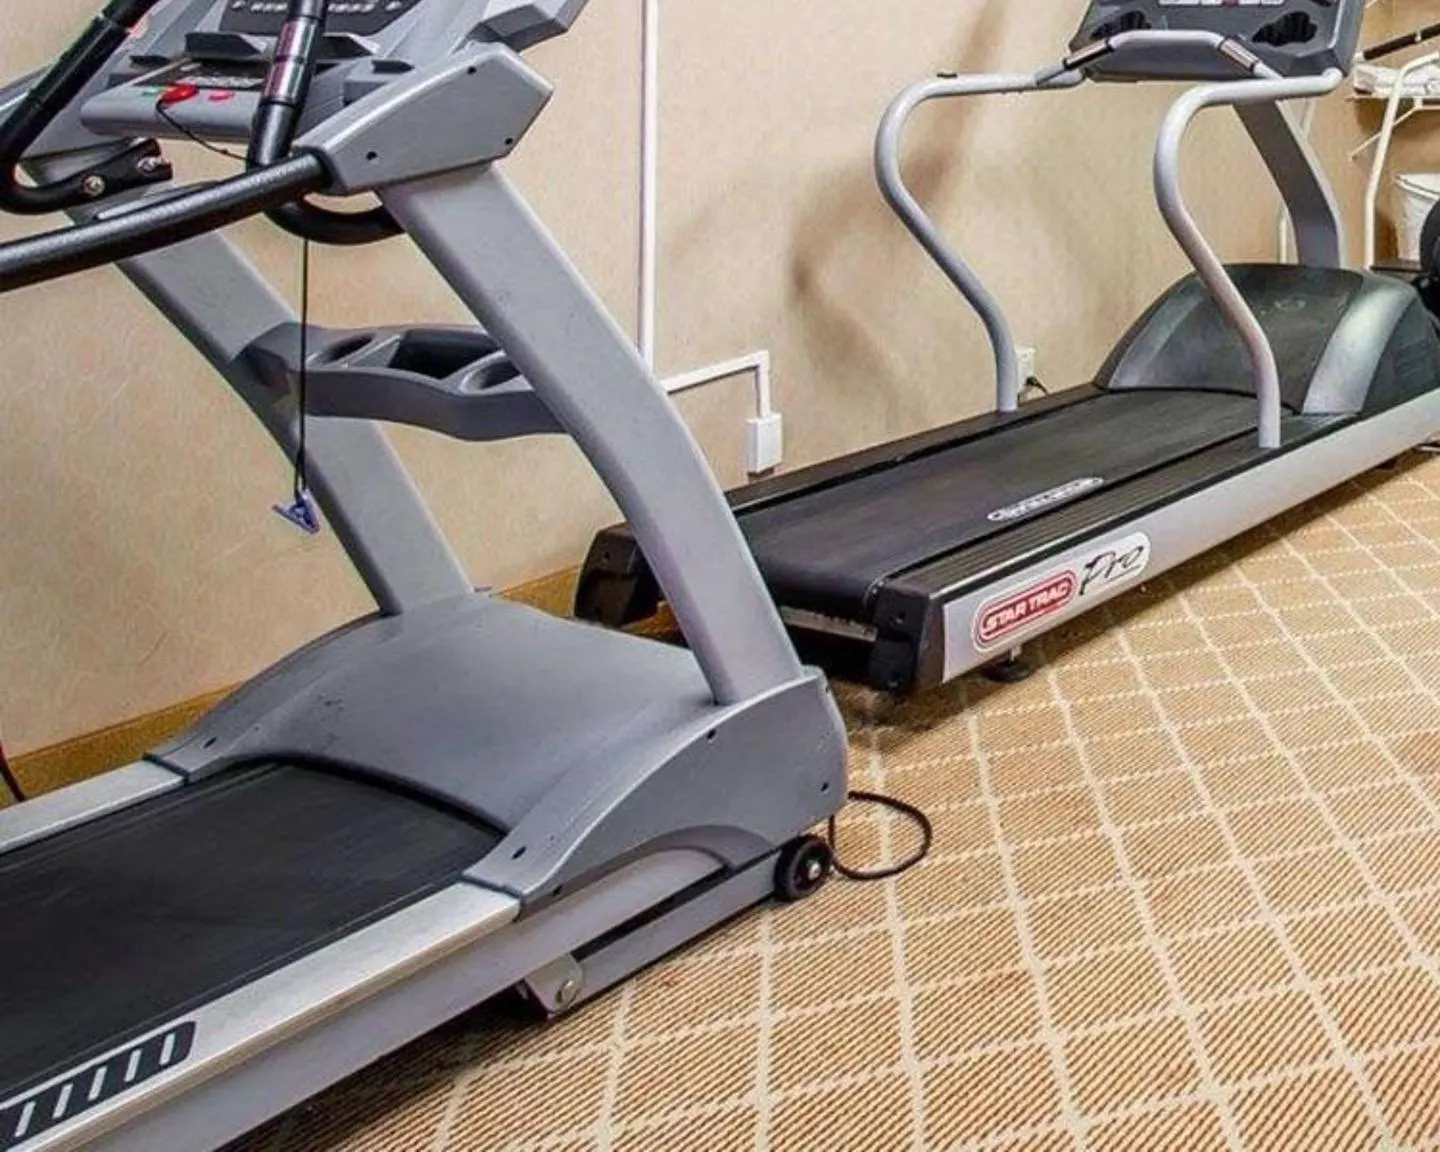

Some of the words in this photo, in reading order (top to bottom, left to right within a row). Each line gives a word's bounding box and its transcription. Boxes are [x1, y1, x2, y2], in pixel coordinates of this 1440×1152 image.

[986, 600, 1028, 629] STAR
[1028, 581, 1069, 611] TRAC
[1078, 545, 1144, 596] Pro
